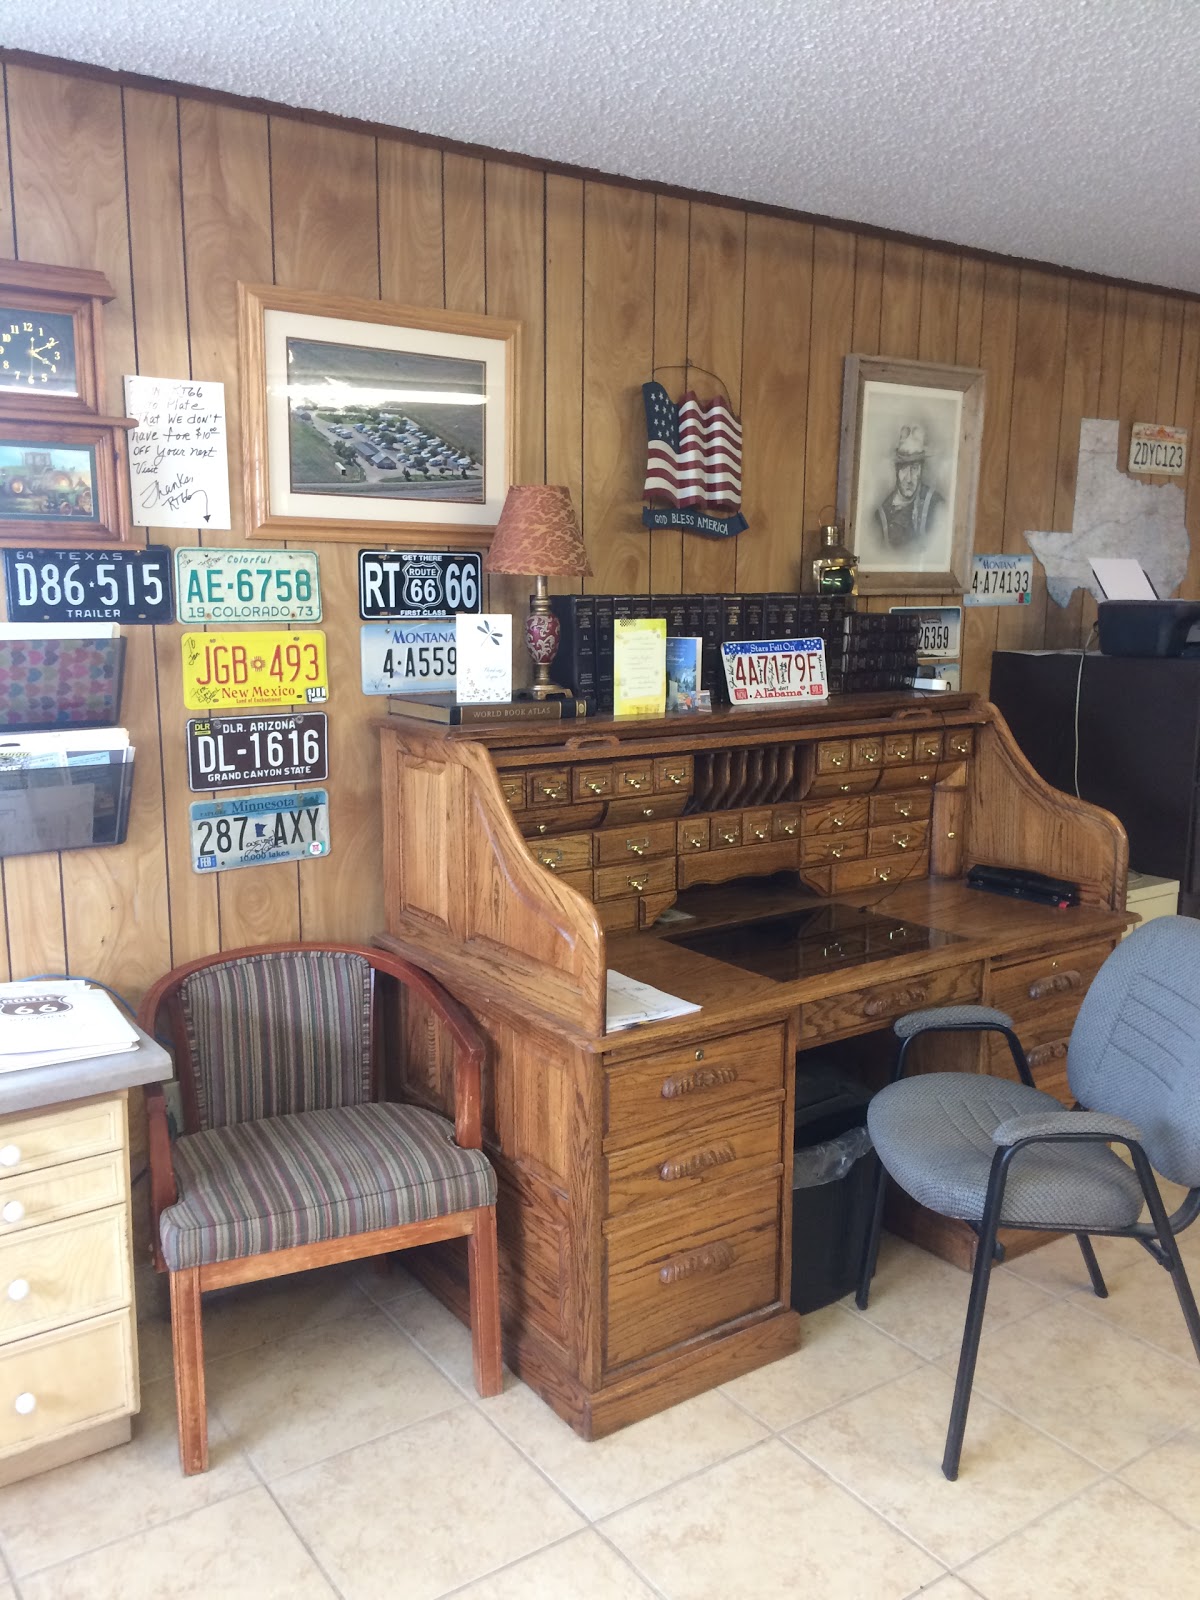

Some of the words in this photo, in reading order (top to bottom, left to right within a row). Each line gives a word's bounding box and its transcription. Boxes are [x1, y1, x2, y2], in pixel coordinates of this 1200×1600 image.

[10, 325, 19, 334] 11
[23, 323, 33, 332] 12
[38, 327, 44, 336] 1
[2, 333, 11, 343] 10
[54, 351, 60, 360] 3
[3, 360, 9, 370] 8
[51, 364, 57, 374] 4
[14, 371, 20, 379] 7
[28, 375, 34, 384] 6
[41, 374, 48, 383] 5
[132, 431, 159, 442] have
[1133, 441, 1183, 468] 2DYC123
[654, 514, 668, 525] GOD
[671, 512, 695, 526] BLESS
[697, 517, 729, 536] AMERICA
[16, 551, 34, 560] 64
[56, 551, 123, 561] TEXAS
[227, 555, 272, 564] Colorful
[983, 560, 1017, 569] MONTANA
[409, 568, 437, 576] ROUTE
[365, 561, 401, 608] RT
[445, 563, 477, 609] 66
[410, 579, 437, 602] 66
[66, 609, 121, 618] TRAILER
[188, 607, 205, 618] 19
[212, 606, 290, 618] COLORADO
[296, 606, 313, 616] 73
[392, 630, 456, 645] MONTANA
[750, 644, 769, 653] Stars
[769, 643, 782, 652] Fell
[783, 642, 795, 651] On
[196, 645, 249, 685] JGB
[269, 644, 319, 683] 493
[735, 652, 817, 686] 4A7179F
[222, 687, 249, 699] New
[252, 686, 295, 698] Mexico
[753, 687, 803, 699] Alabama
[473, 710, 502, 718] WORLD
[527, 707, 551, 715] ATLAS
[195, 723, 210, 731] DLR
[222, 723, 247, 734] DLR.
[250, 720, 296, 732] ARIZONA
[197, 729, 319, 774] DL-1616
[208, 771, 242, 782] GRAND
[243, 768, 282, 779] CANYON
[284, 765, 312, 775] STATE
[232, 798, 294, 813] Minnesota
[197, 816, 249, 856] 287
[273, 807, 319, 847] AXY
[240, 852, 267, 863] 10,000
[269, 850, 290, 859] lakes
[199, 857, 212, 868] FEB
[14, 1004, 58, 1015] 66
